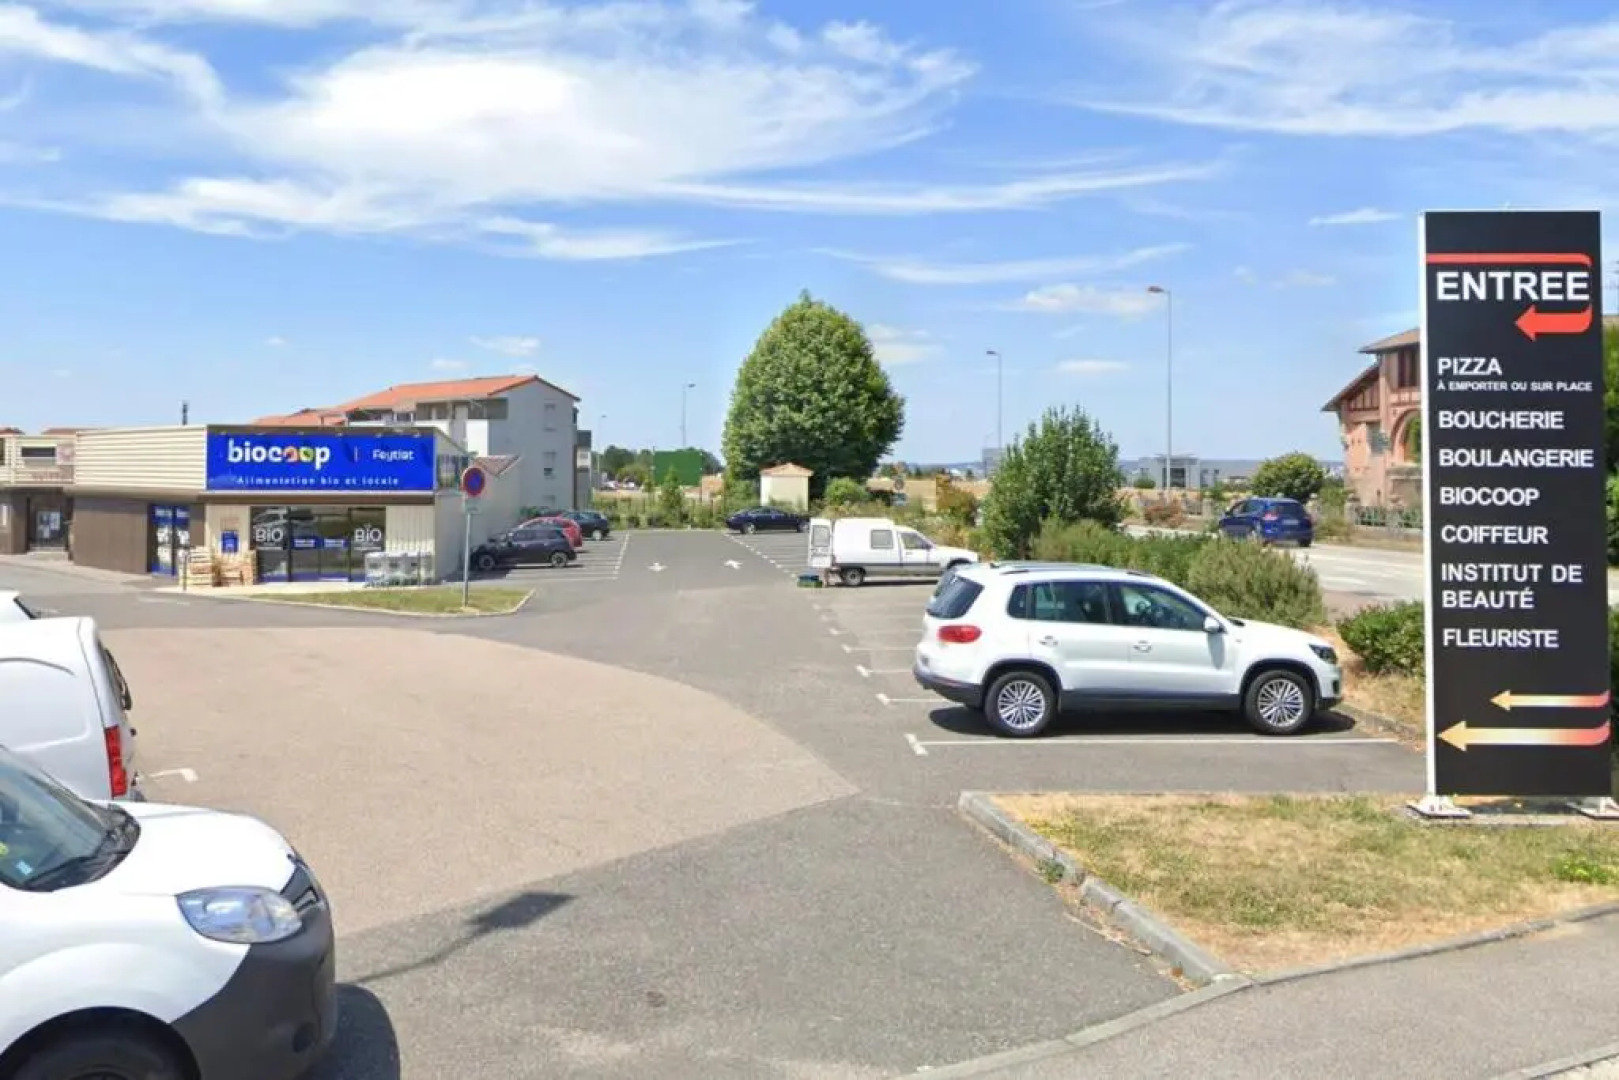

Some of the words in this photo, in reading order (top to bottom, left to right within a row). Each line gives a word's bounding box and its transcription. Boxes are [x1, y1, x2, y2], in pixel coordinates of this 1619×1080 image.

[1436, 271, 1590, 301] ENTREE
[1437, 357, 1503, 376] PIZZA
[1436, 379, 1446, 392] À
[1449, 381, 1508, 392] EMPORTER
[1510, 381, 1527, 392] OU
[1530, 381, 1553, 392] SUR
[1556, 381, 1593, 392] PLACE
[1438, 410, 1565, 430] BOUCHERIE
[228, 438, 331, 471] biocoop
[1439, 448, 1595, 468] BOULANGERIE
[320, 476, 340, 486] bio
[345, 477, 358, 486] et
[1440, 486, 1540, 506] BIOCOOP
[1441, 525, 1549, 545] COIFFEUR
[1441, 563, 1543, 583] INSTITUT
[1551, 565, 1583, 583] DE
[1441, 587, 1535, 609] BEAUTÉ
[1442, 629, 1560, 648] FLEURISTE
